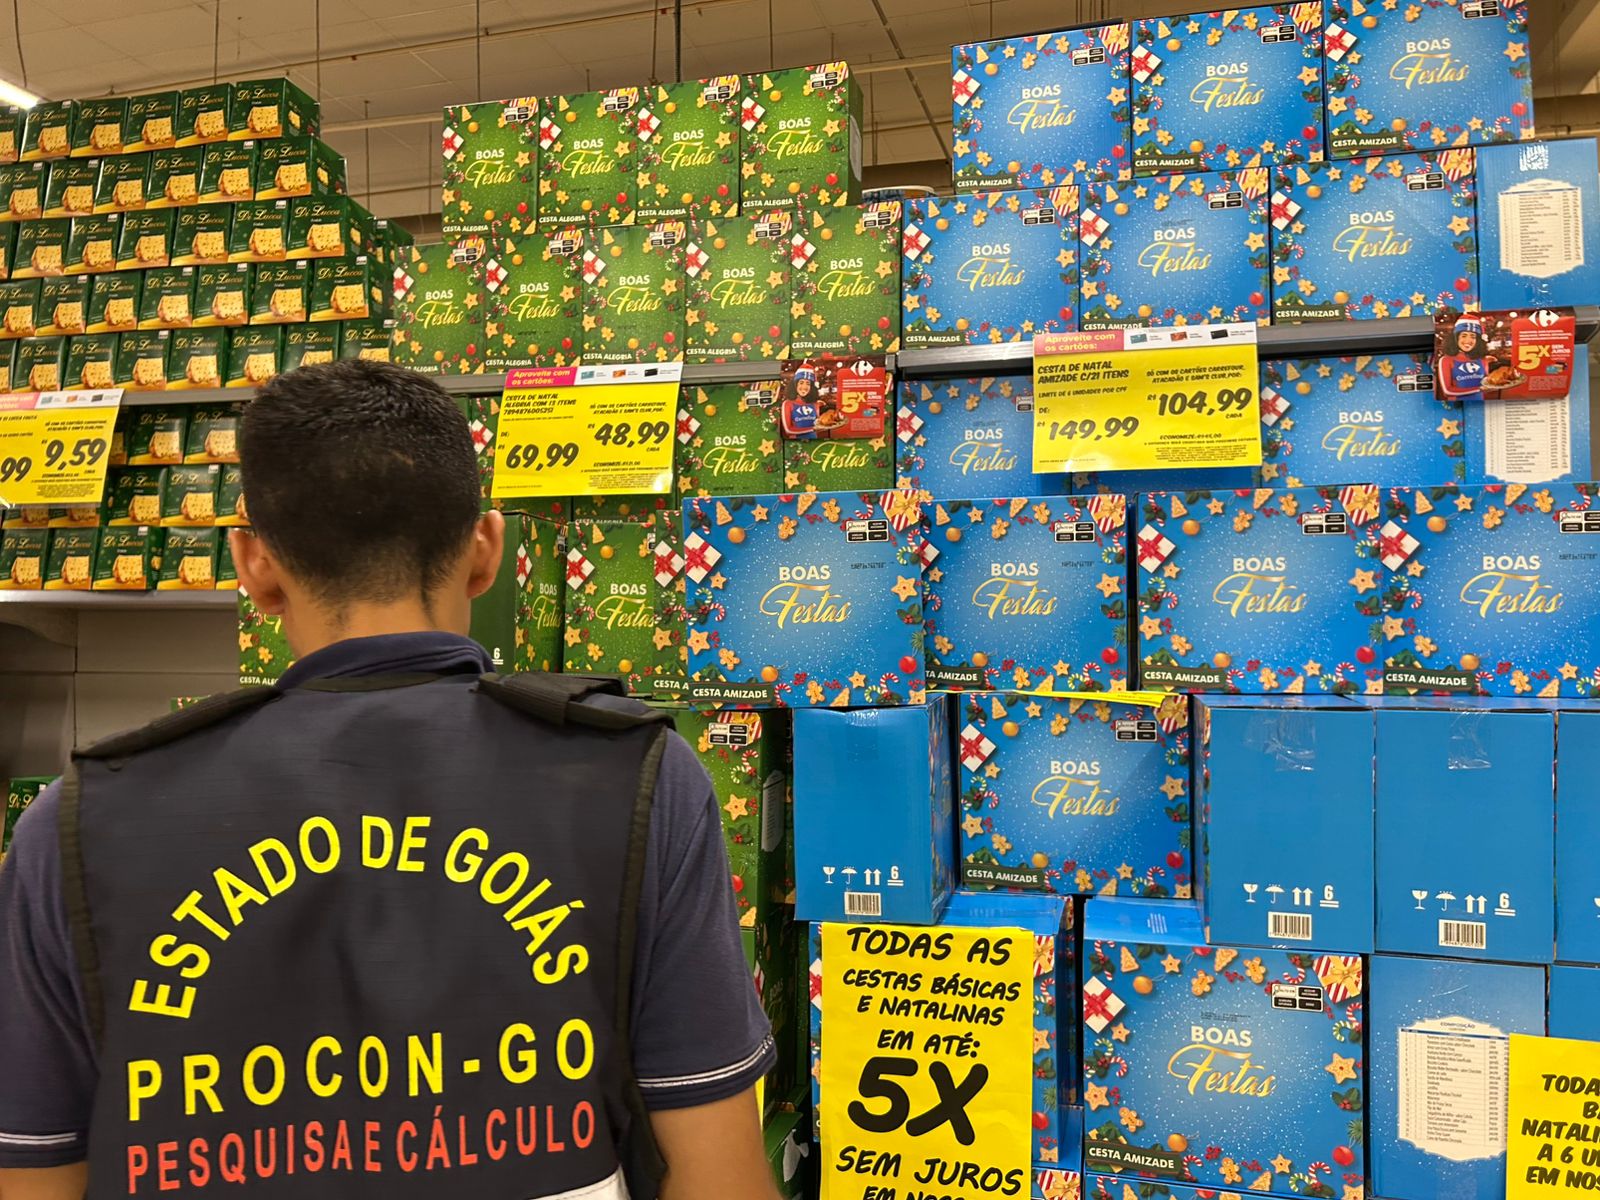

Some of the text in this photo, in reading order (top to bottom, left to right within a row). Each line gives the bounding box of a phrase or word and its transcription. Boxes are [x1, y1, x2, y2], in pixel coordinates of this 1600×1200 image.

[1406, 38, 1451, 53] BOAS
[1390, 53, 1469, 89] Festas
[1022, 85, 1061, 99] BOAS
[779, 118, 811, 130] BOAS
[1007, 99, 1076, 134] Festas
[767, 129, 824, 160] Festas
[1333, 137, 1397, 147] CESTA AMIZADE
[476, 148, 504, 160] BOAS
[465, 160, 515, 188] Festas
[763, 198, 793, 206] ALEGRIA
[1350, 210, 1394, 225] BOAS
[972, 244, 1010, 256] BOAS
[1333, 226, 1411, 263] Festas
[831, 258, 863, 270] BOAS
[956, 257, 1026, 292] Festas
[520, 282, 549, 293] BOAS
[817, 271, 876, 301] Festas
[509, 294, 560, 322] Festas
[1276, 309, 1340, 318] CESTA AMIZADE
[906, 335, 927, 343] CESTA
[1045, 334, 1092, 344] Aproveite
[1058, 342, 1097, 351] cartões:
[1038, 361, 1112, 374] CESTA DE NATAL
[1038, 370, 1129, 384] AMIZADE C/21 ITENS
[522, 377, 554, 385] cartões:
[1158, 387, 1252, 416] 104,99
[1339, 410, 1384, 423] BOAS
[594, 421, 670, 448] 48,99
[965, 429, 1003, 440] BOAS
[1049, 416, 1139, 441] 149,99
[715, 436, 746, 446] BOAS
[1322, 424, 1400, 461] Festas
[45, 438, 107, 470] 9,59
[506, 443, 579, 471] 69,99
[703, 447, 759, 477] Festas
[950, 441, 1018, 475] Festas
[1482, 555, 1540, 570] BOAS
[779, 565, 831, 581] BOAS
[610, 583, 647, 595] BOAS
[1460, 572, 1563, 618] Festas
[760, 582, 852, 629] Festas
[494, 648, 501, 660] 6
[1386, 673, 1467, 686] CESTA AMIZADE
[693, 687, 768, 699] CESTA AMIZADE
[1051, 760, 1100, 775] BOAS
[1031, 776, 1119, 820] Festas
[891, 866, 898, 879] 6
[967, 870, 1038, 883] CESTA AMIZADE
[1324, 885, 1334, 900] 6
[1499, 892, 1509, 908] 6
[129, 815, 589, 1019] ESTADO DE GOIÁS
[847, 927, 1012, 966] TODAS AS
[843, 969, 1021, 1001] CESTAS BÁSICAS
[857, 996, 1005, 1026] E NATALINAS
[878, 1029, 980, 1058] EM ATÉ:
[1191, 1026, 1252, 1047] BOAS
[1168, 1044, 1277, 1097] Festas
[848, 1057, 988, 1146] 5X
[396, 1101, 594, 1172] CÁLCULO
[1089, 1147, 1174, 1168] CESTA AMIZADE
[1537, 1144, 1553, 1162] A
[1561, 1146, 1574, 1164] 6
[836, 1146, 1023, 1195] SEM JUROS
[1526, 1166, 1560, 1186] EM
